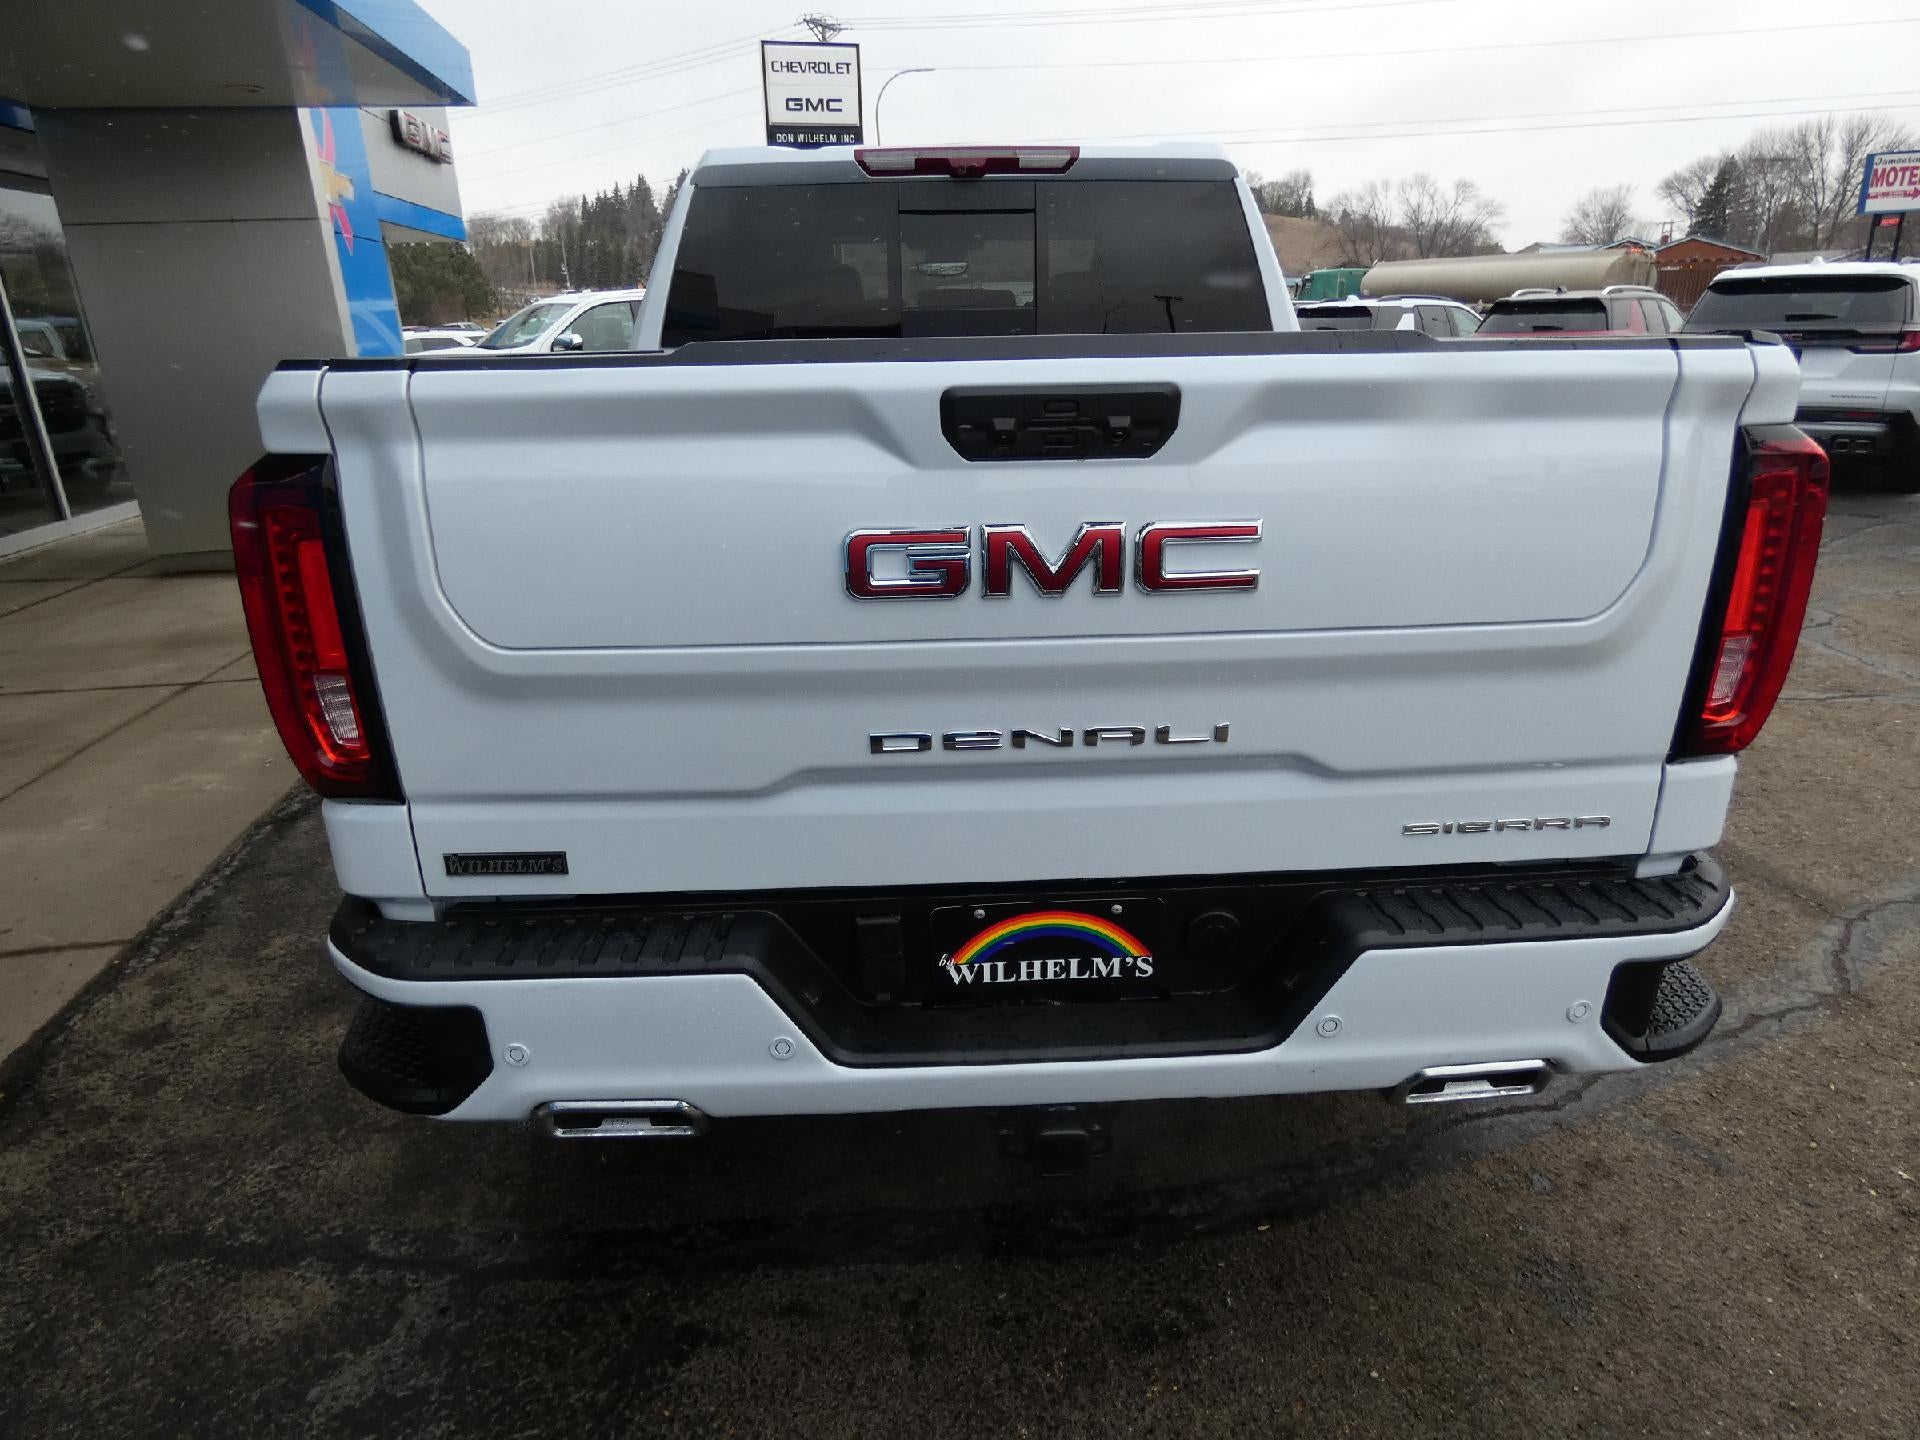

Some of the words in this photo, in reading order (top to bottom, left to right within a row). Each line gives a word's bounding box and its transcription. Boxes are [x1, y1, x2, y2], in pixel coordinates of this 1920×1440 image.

[771, 60, 852, 75] CHEVROLET
[785, 97, 843, 112] GMC
[395, 110, 454, 164] GMC
[776, 133, 794, 143] DON
[797, 134, 837, 143] WILHELM
[841, 134, 855, 143] INC
[1870, 165, 1920, 188] MOTE
[842, 517, 1264, 601] GMC
[869, 721, 1231, 755] DENALI
[1401, 815, 1611, 836] SIERRA
[449, 858, 563, 873] WILHELM'S
[938, 953, 957, 970] by
[947, 955, 1155, 986] WILHELM'S
